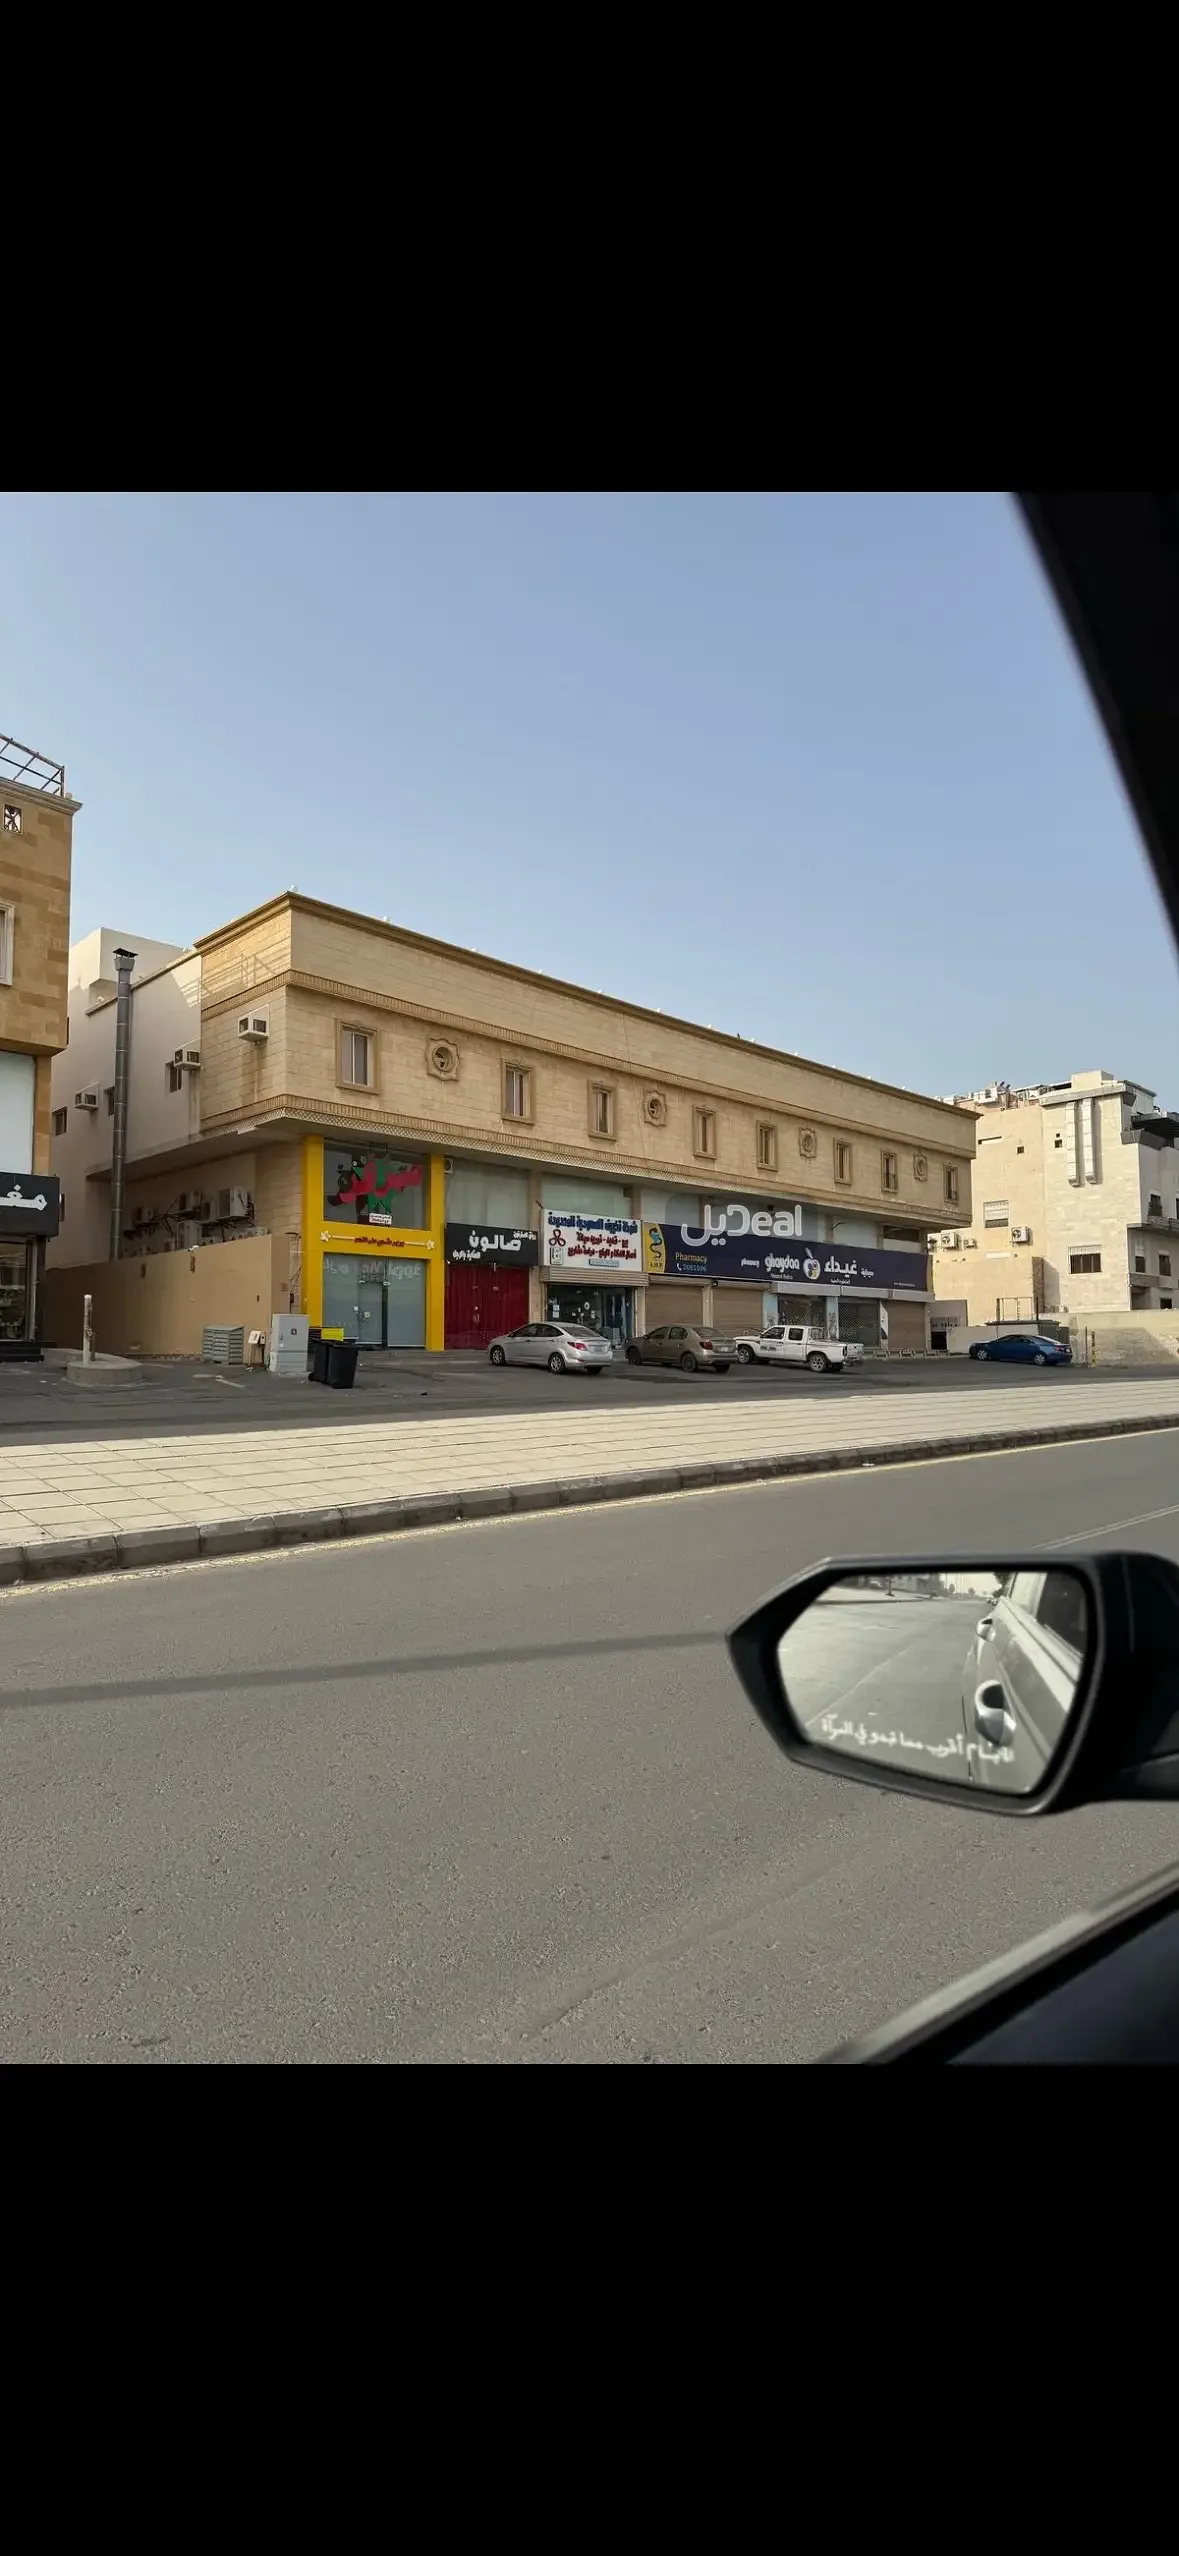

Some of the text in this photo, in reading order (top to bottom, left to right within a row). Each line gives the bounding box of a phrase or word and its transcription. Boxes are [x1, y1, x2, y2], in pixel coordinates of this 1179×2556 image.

[469, 1229, 522, 1252] صالون
[675, 1252, 708, 1265] Pharmacy
[764, 1252, 800, 1273] ghaydaa
[824, 1255, 858, 1278] غيداء
[853, 1722, 868, 1746] في
[867, 1730, 898, 1748] تبدو
[925, 1732, 964, 1758] أقرب
